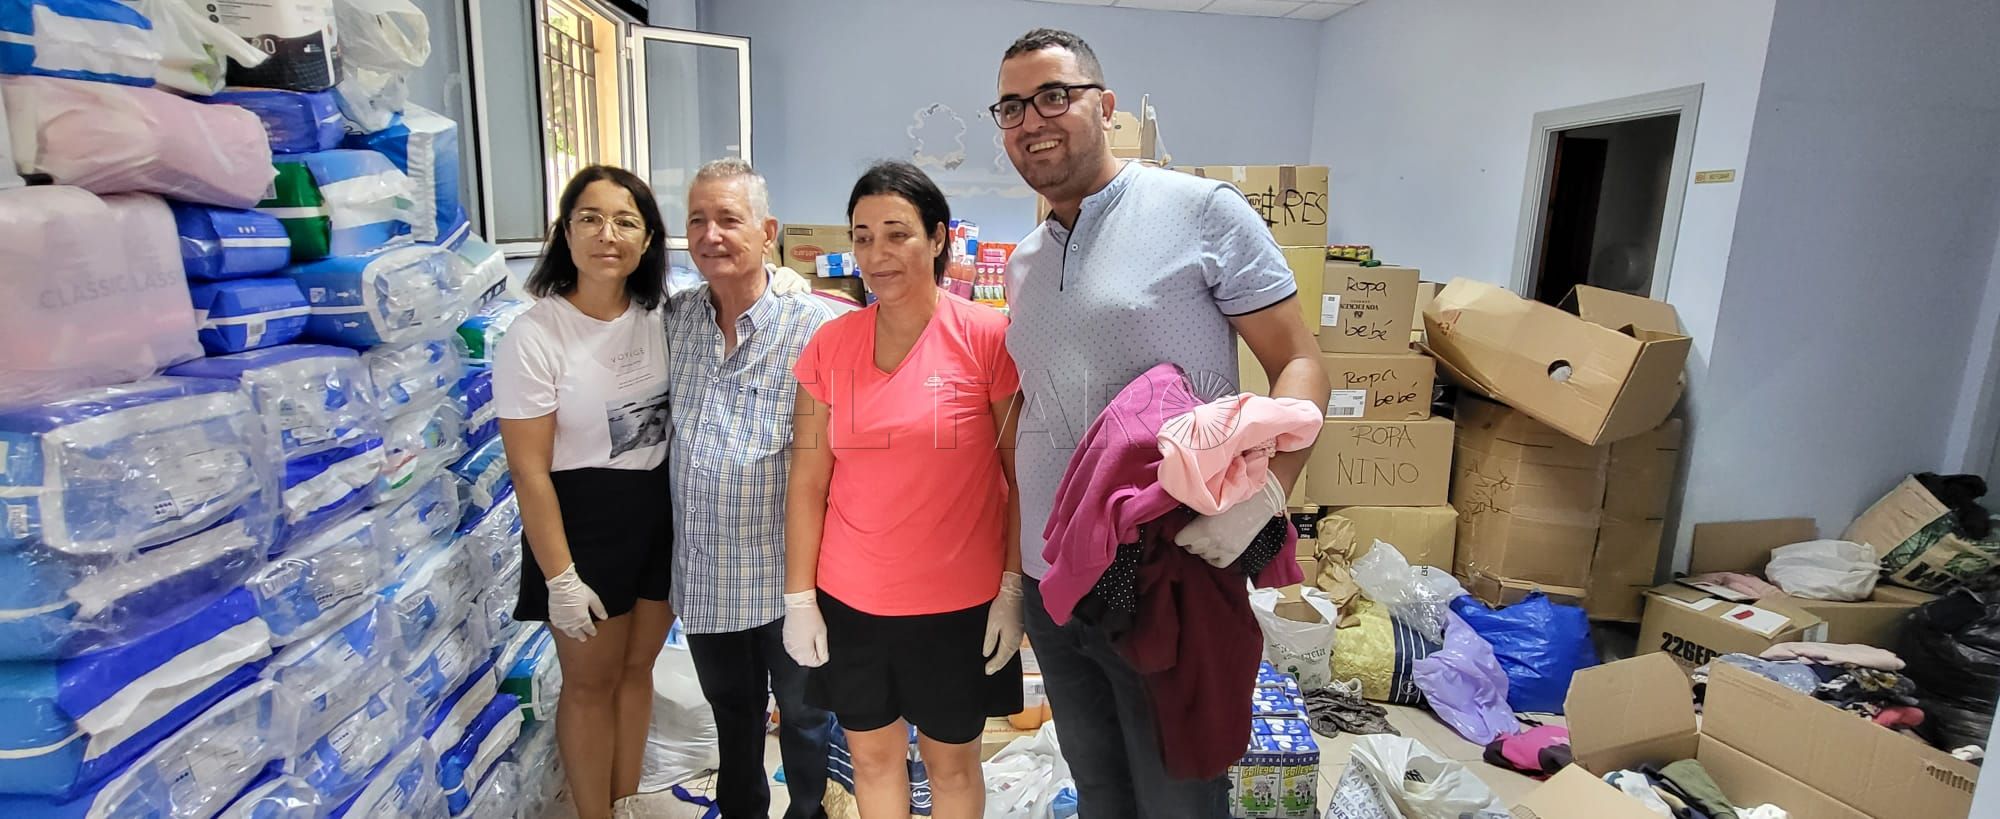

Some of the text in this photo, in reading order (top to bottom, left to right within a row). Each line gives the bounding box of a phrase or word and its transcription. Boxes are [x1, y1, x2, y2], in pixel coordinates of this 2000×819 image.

[1344, 319, 1393, 341] bebé
[1373, 381, 1417, 408] bebé
[1351, 424, 1416, 448] ROPA
[1337, 451, 1419, 487] NIÑO
